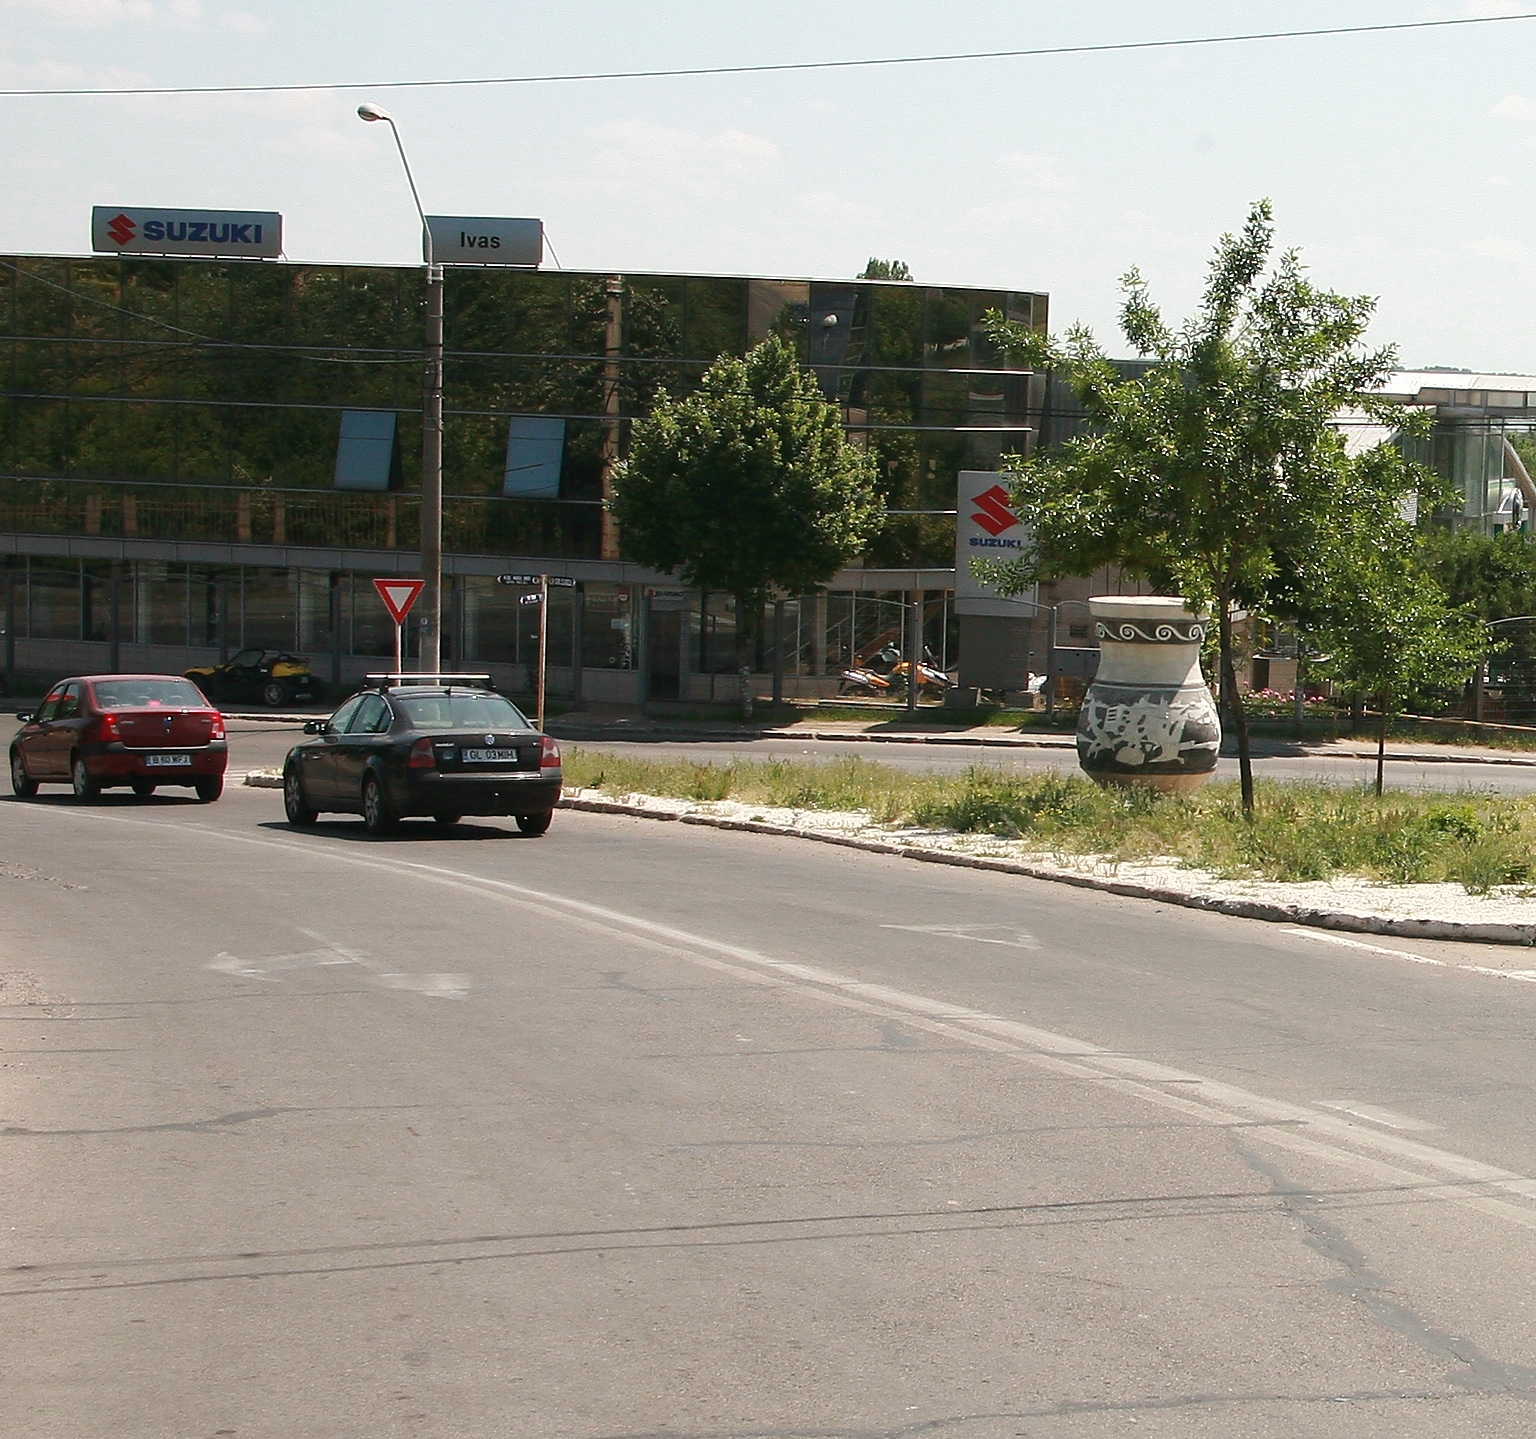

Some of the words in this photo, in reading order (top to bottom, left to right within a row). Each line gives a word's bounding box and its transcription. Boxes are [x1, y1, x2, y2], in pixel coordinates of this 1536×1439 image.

[143, 220, 263, 244] SUZUKI
[460, 231, 501, 249] Ivas
[969, 537, 1021, 548] SUZUKI
